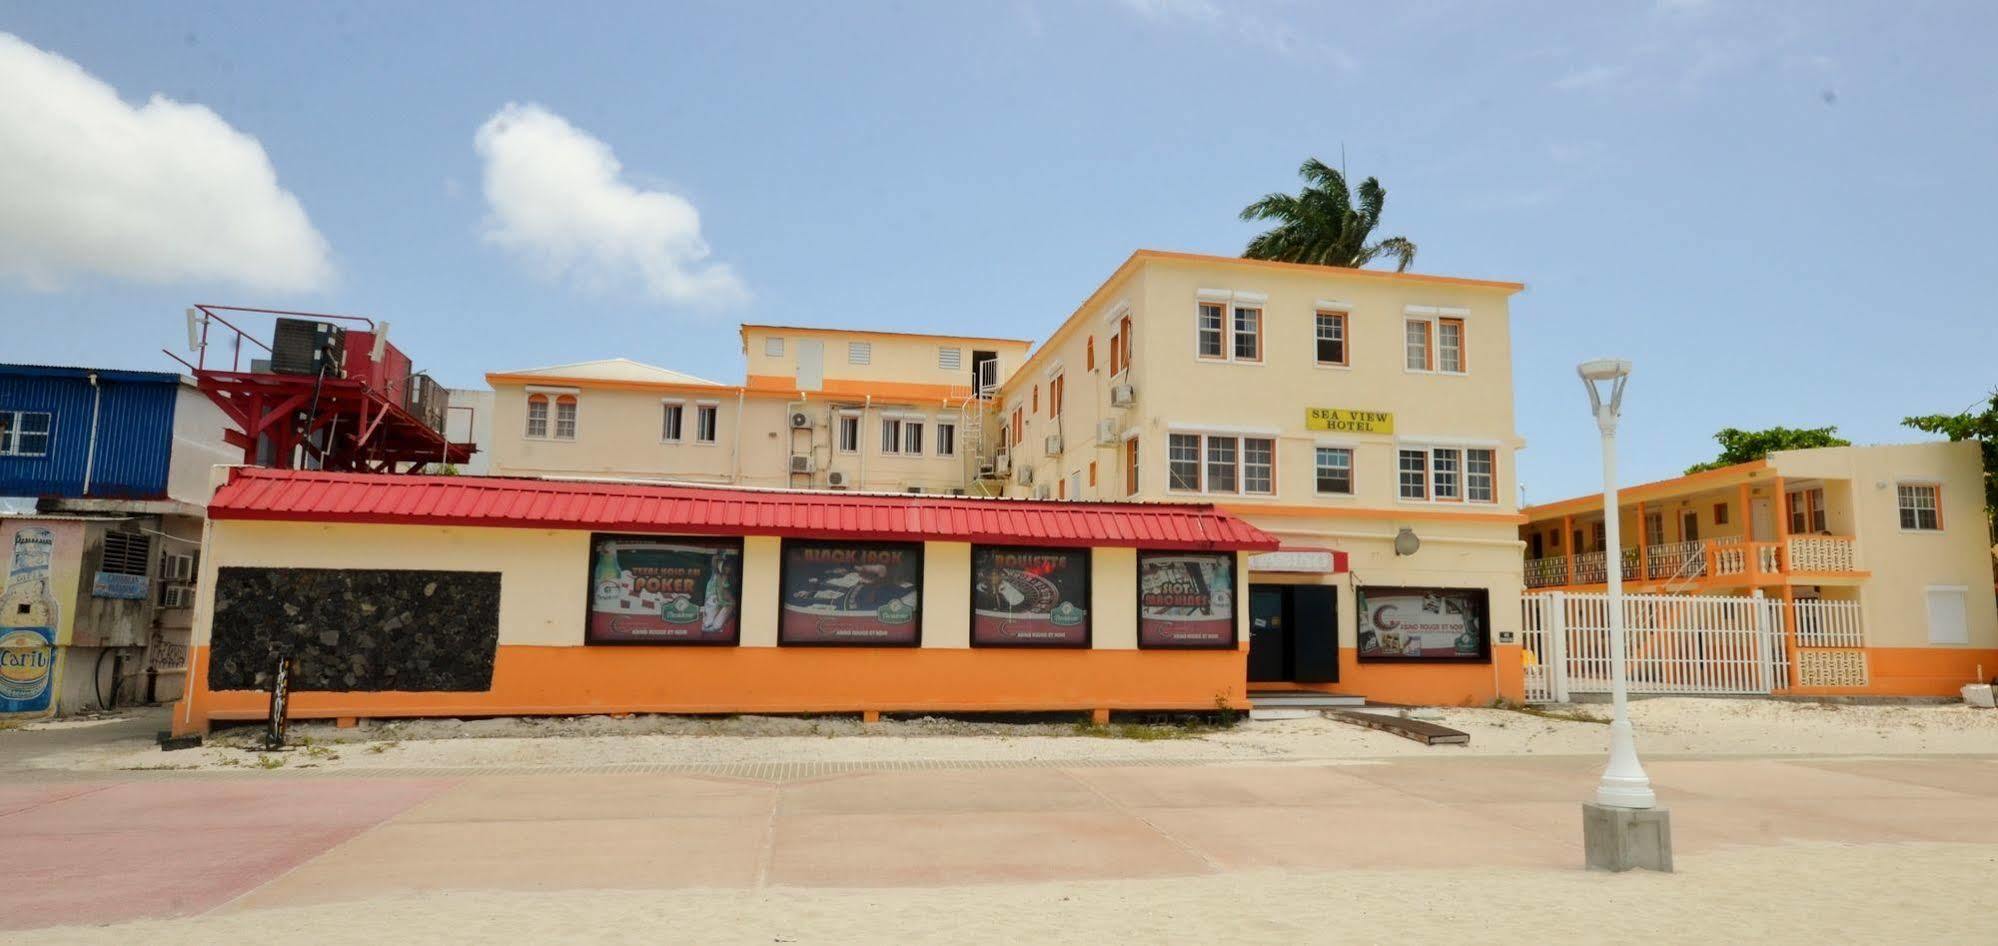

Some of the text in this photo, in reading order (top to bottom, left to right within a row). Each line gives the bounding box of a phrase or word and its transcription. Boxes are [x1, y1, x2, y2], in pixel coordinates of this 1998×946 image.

[1312, 409, 1388, 422] SEA VIEW
[1327, 420, 1374, 432] HOTEL
[804, 549, 902, 563] BLACK JACK
[634, 577, 695, 592] POKER
[1162, 582, 1190, 594] SLOT
[1144, 594, 1209, 606] MACHINES
[0, 650, 47, 667] Carib
